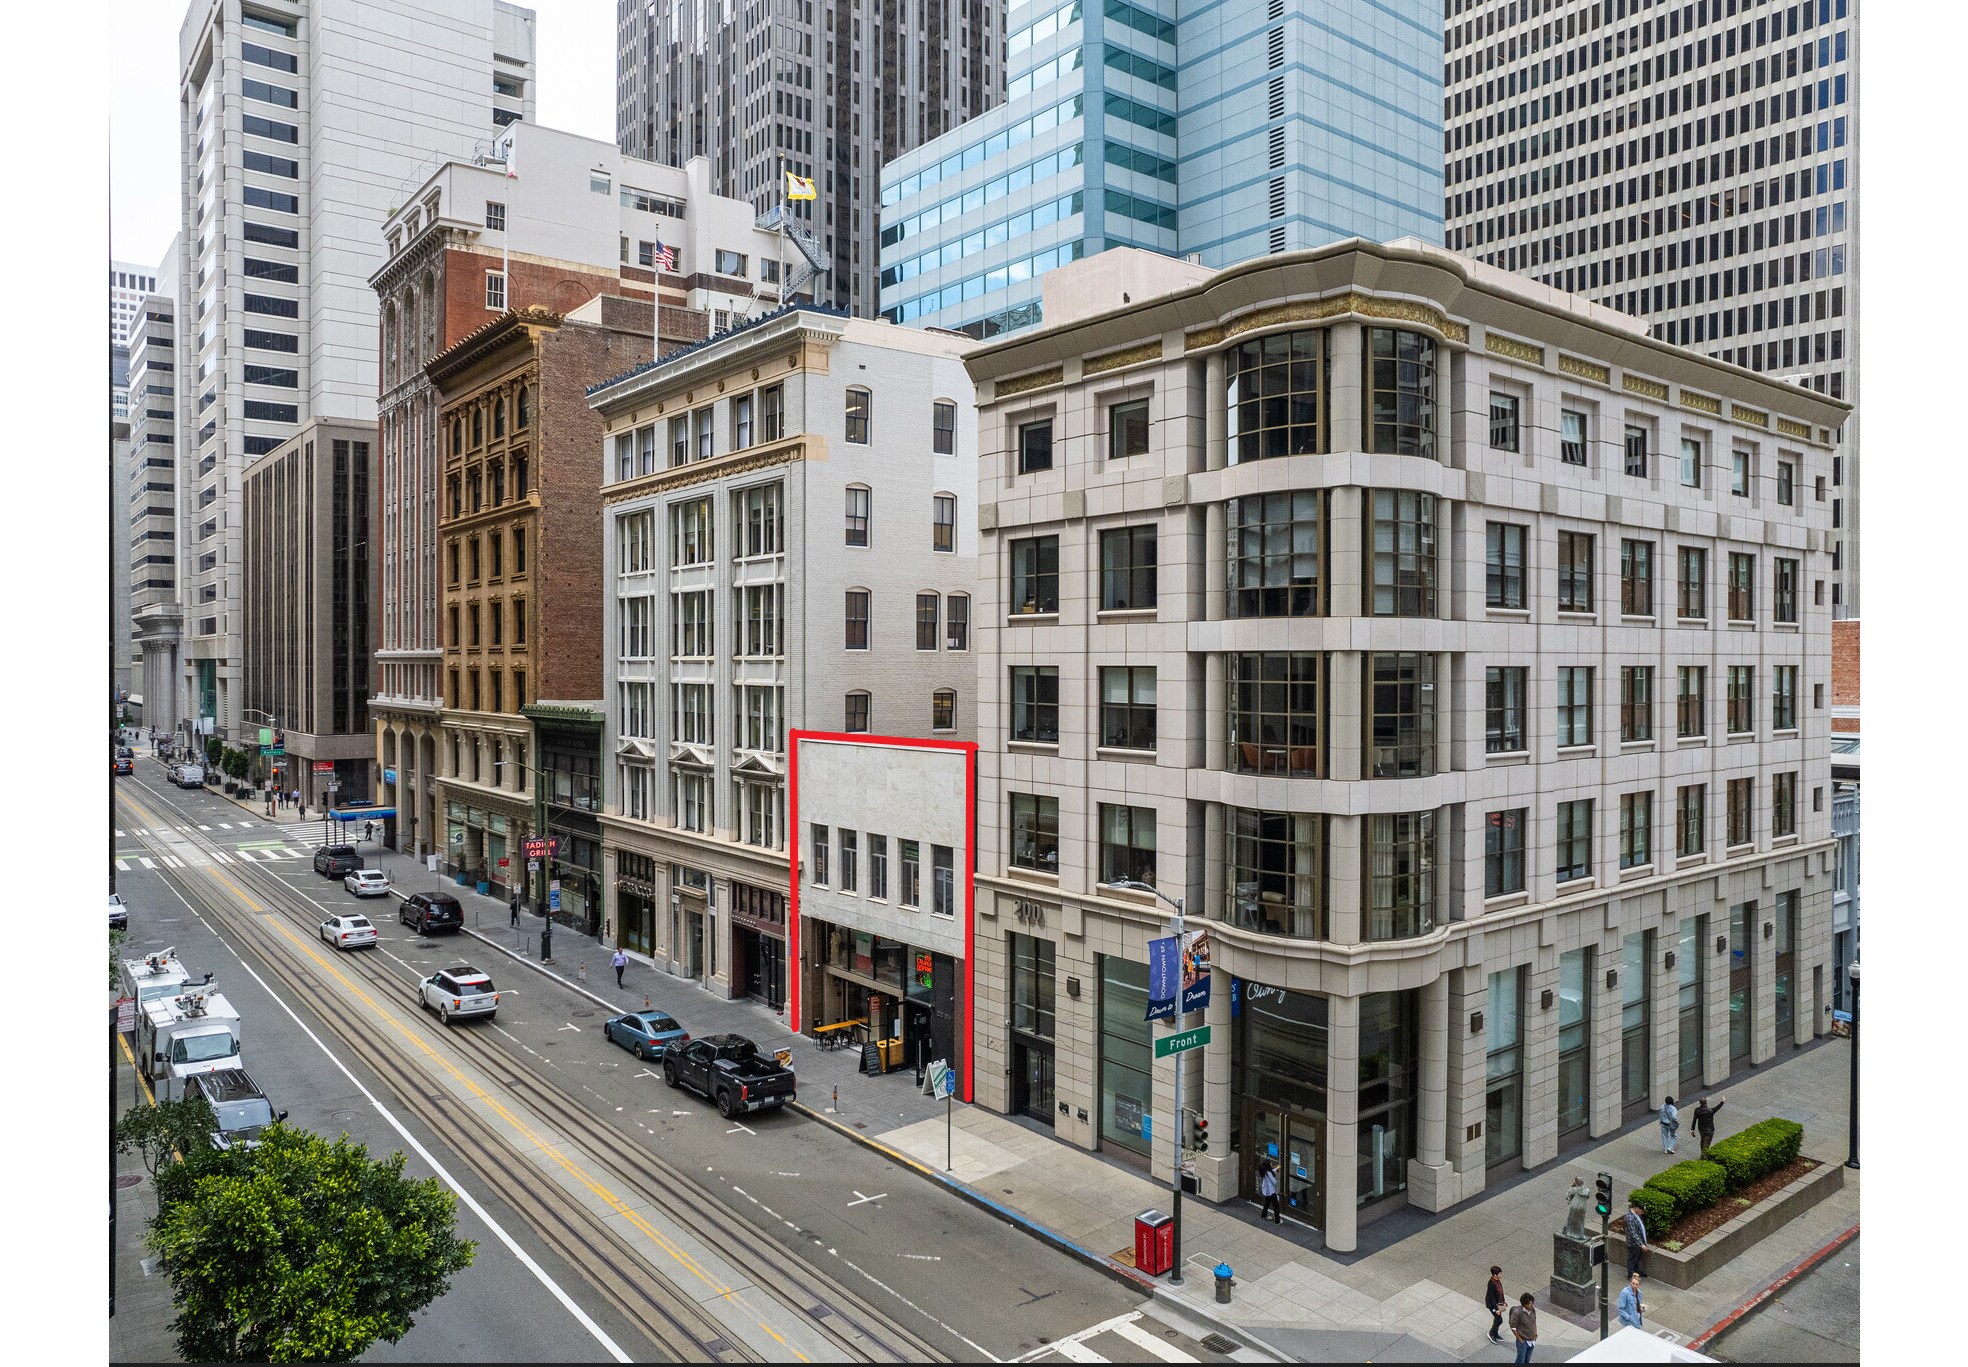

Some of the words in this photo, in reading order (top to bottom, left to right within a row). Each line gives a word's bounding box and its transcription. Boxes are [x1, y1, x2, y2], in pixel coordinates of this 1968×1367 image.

[526, 841, 556, 849] TADIH
[1014, 900, 1041, 920] 200
[1186, 990, 1207, 1002] Dream
[1170, 1034, 1197, 1050] Front
